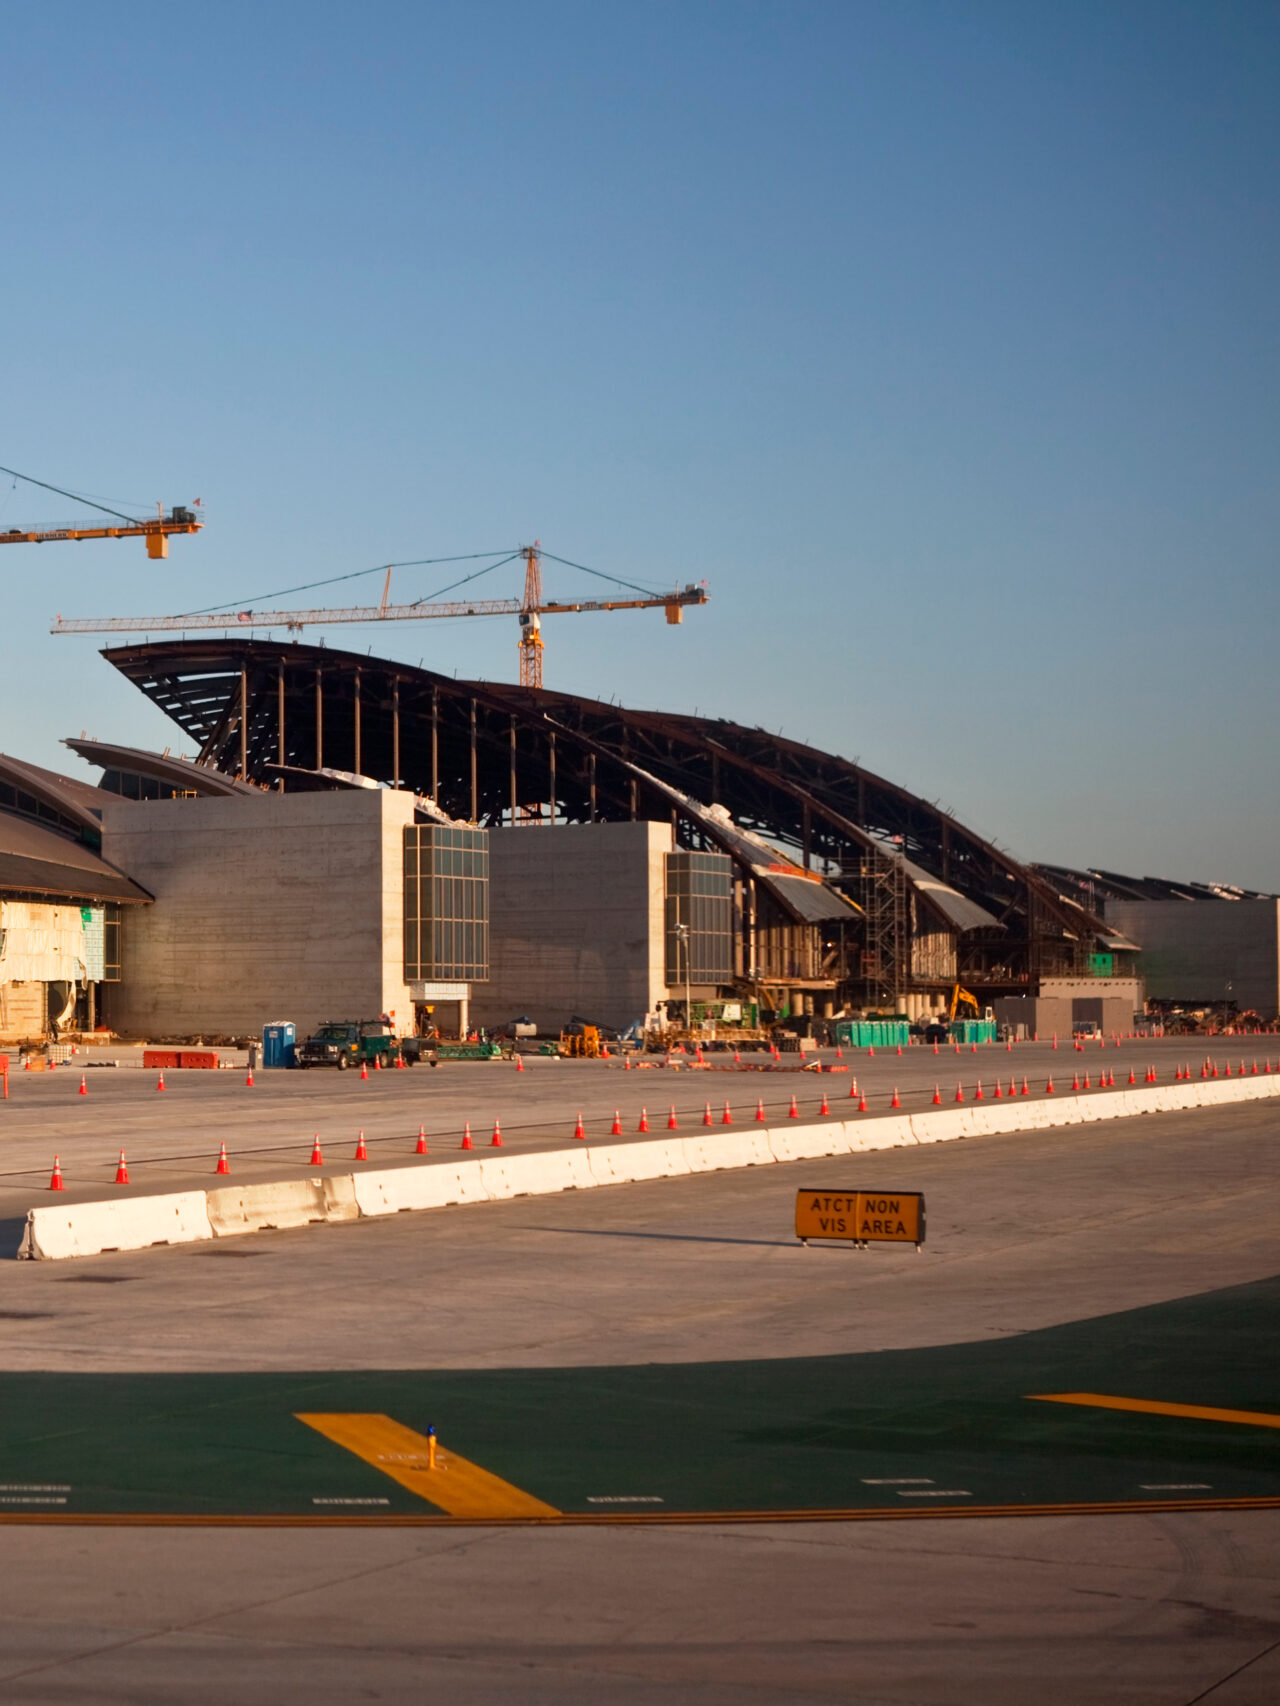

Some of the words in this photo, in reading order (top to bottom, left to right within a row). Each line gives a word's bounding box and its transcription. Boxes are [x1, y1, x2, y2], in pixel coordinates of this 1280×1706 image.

[811, 1198, 854, 1212] ATCT
[865, 1200, 900, 1214] NON
[819, 1218, 847, 1232] VIS
[861, 1220, 907, 1234] AREA
